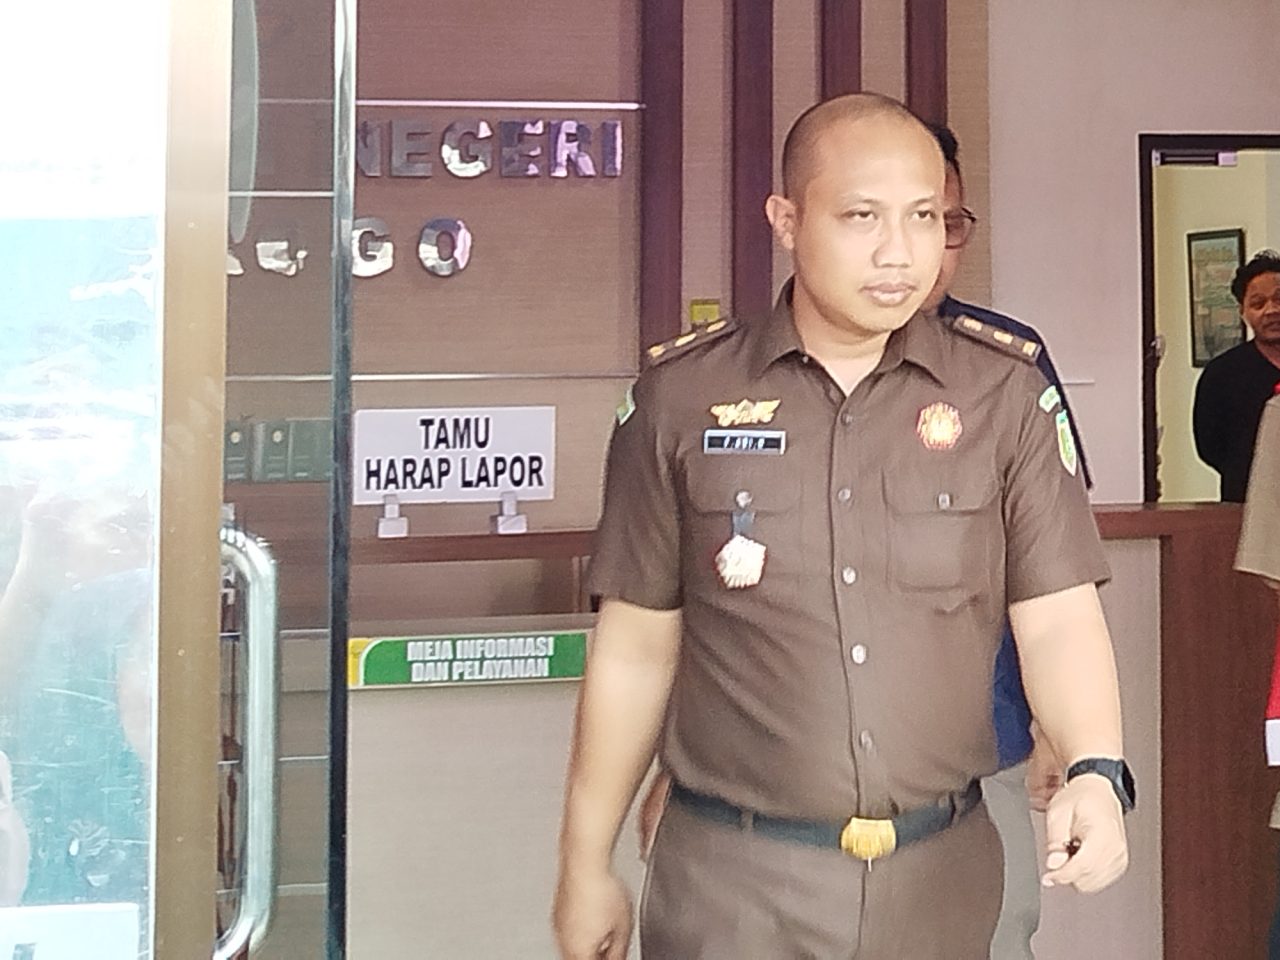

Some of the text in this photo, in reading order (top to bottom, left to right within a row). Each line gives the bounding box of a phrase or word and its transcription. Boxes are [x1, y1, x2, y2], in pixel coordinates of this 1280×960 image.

[356, 120, 623, 178] NEGERI
[419, 416, 492, 450] TAMU
[365, 455, 544, 490] HARAP LAPOR
[407, 637, 554, 661] MEJA INFORMASI
[411, 658, 550, 682] DAN PELAYANAN
